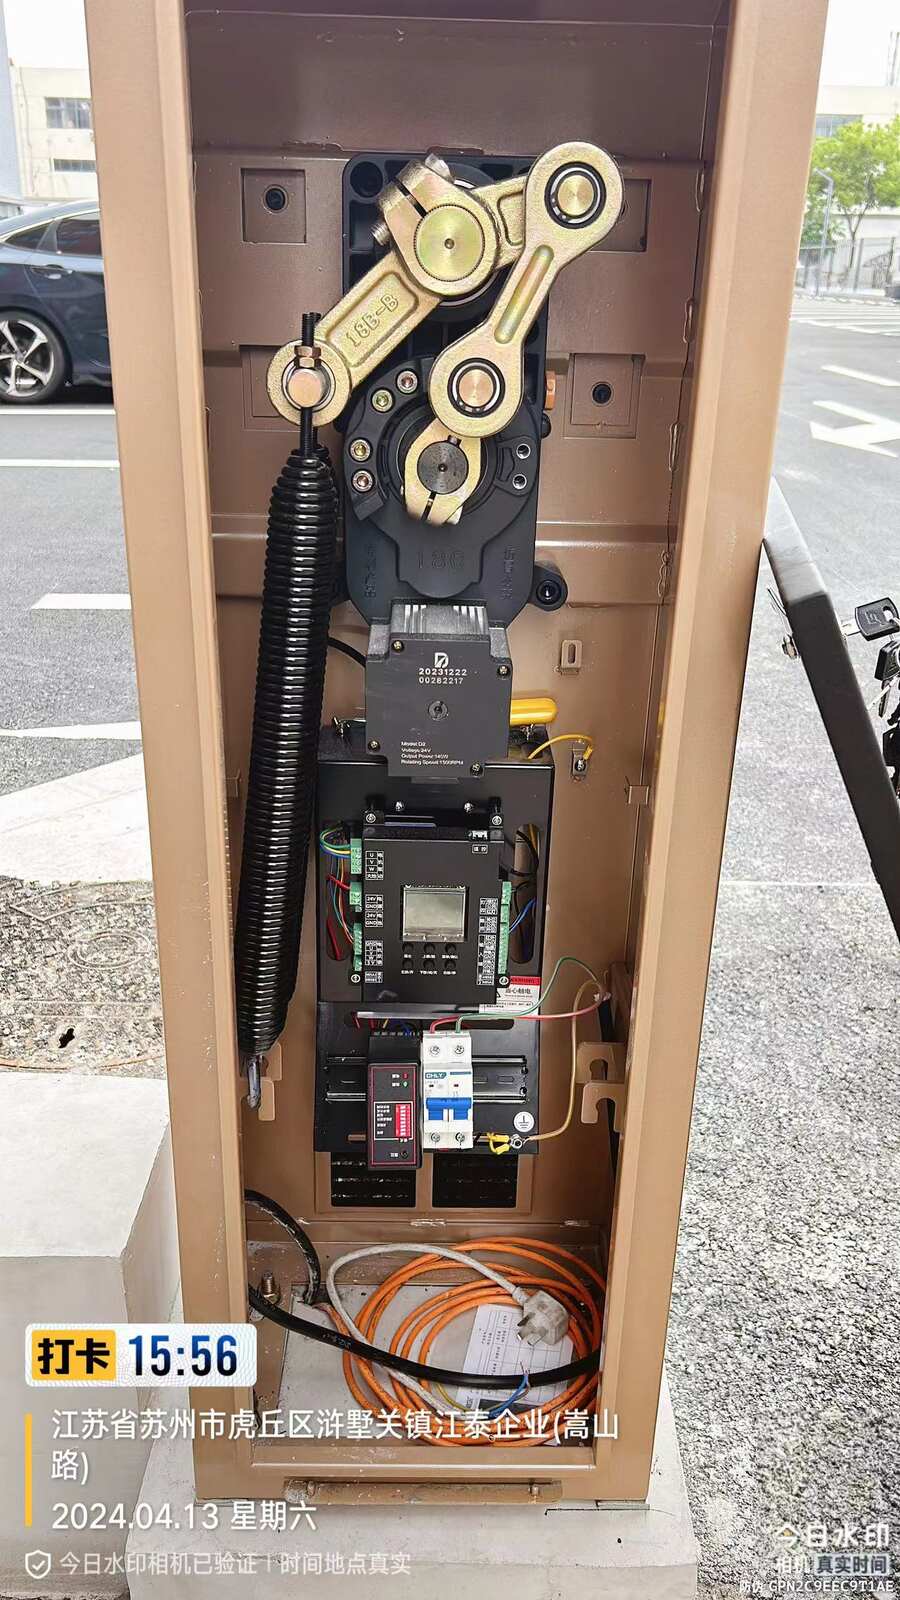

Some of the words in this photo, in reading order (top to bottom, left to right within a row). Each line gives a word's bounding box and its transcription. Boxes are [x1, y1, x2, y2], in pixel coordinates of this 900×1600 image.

[346, 294, 399, 347] 18B-B
[418, 668, 468, 676] 20231222
[418, 676, 464, 684] 00282217
